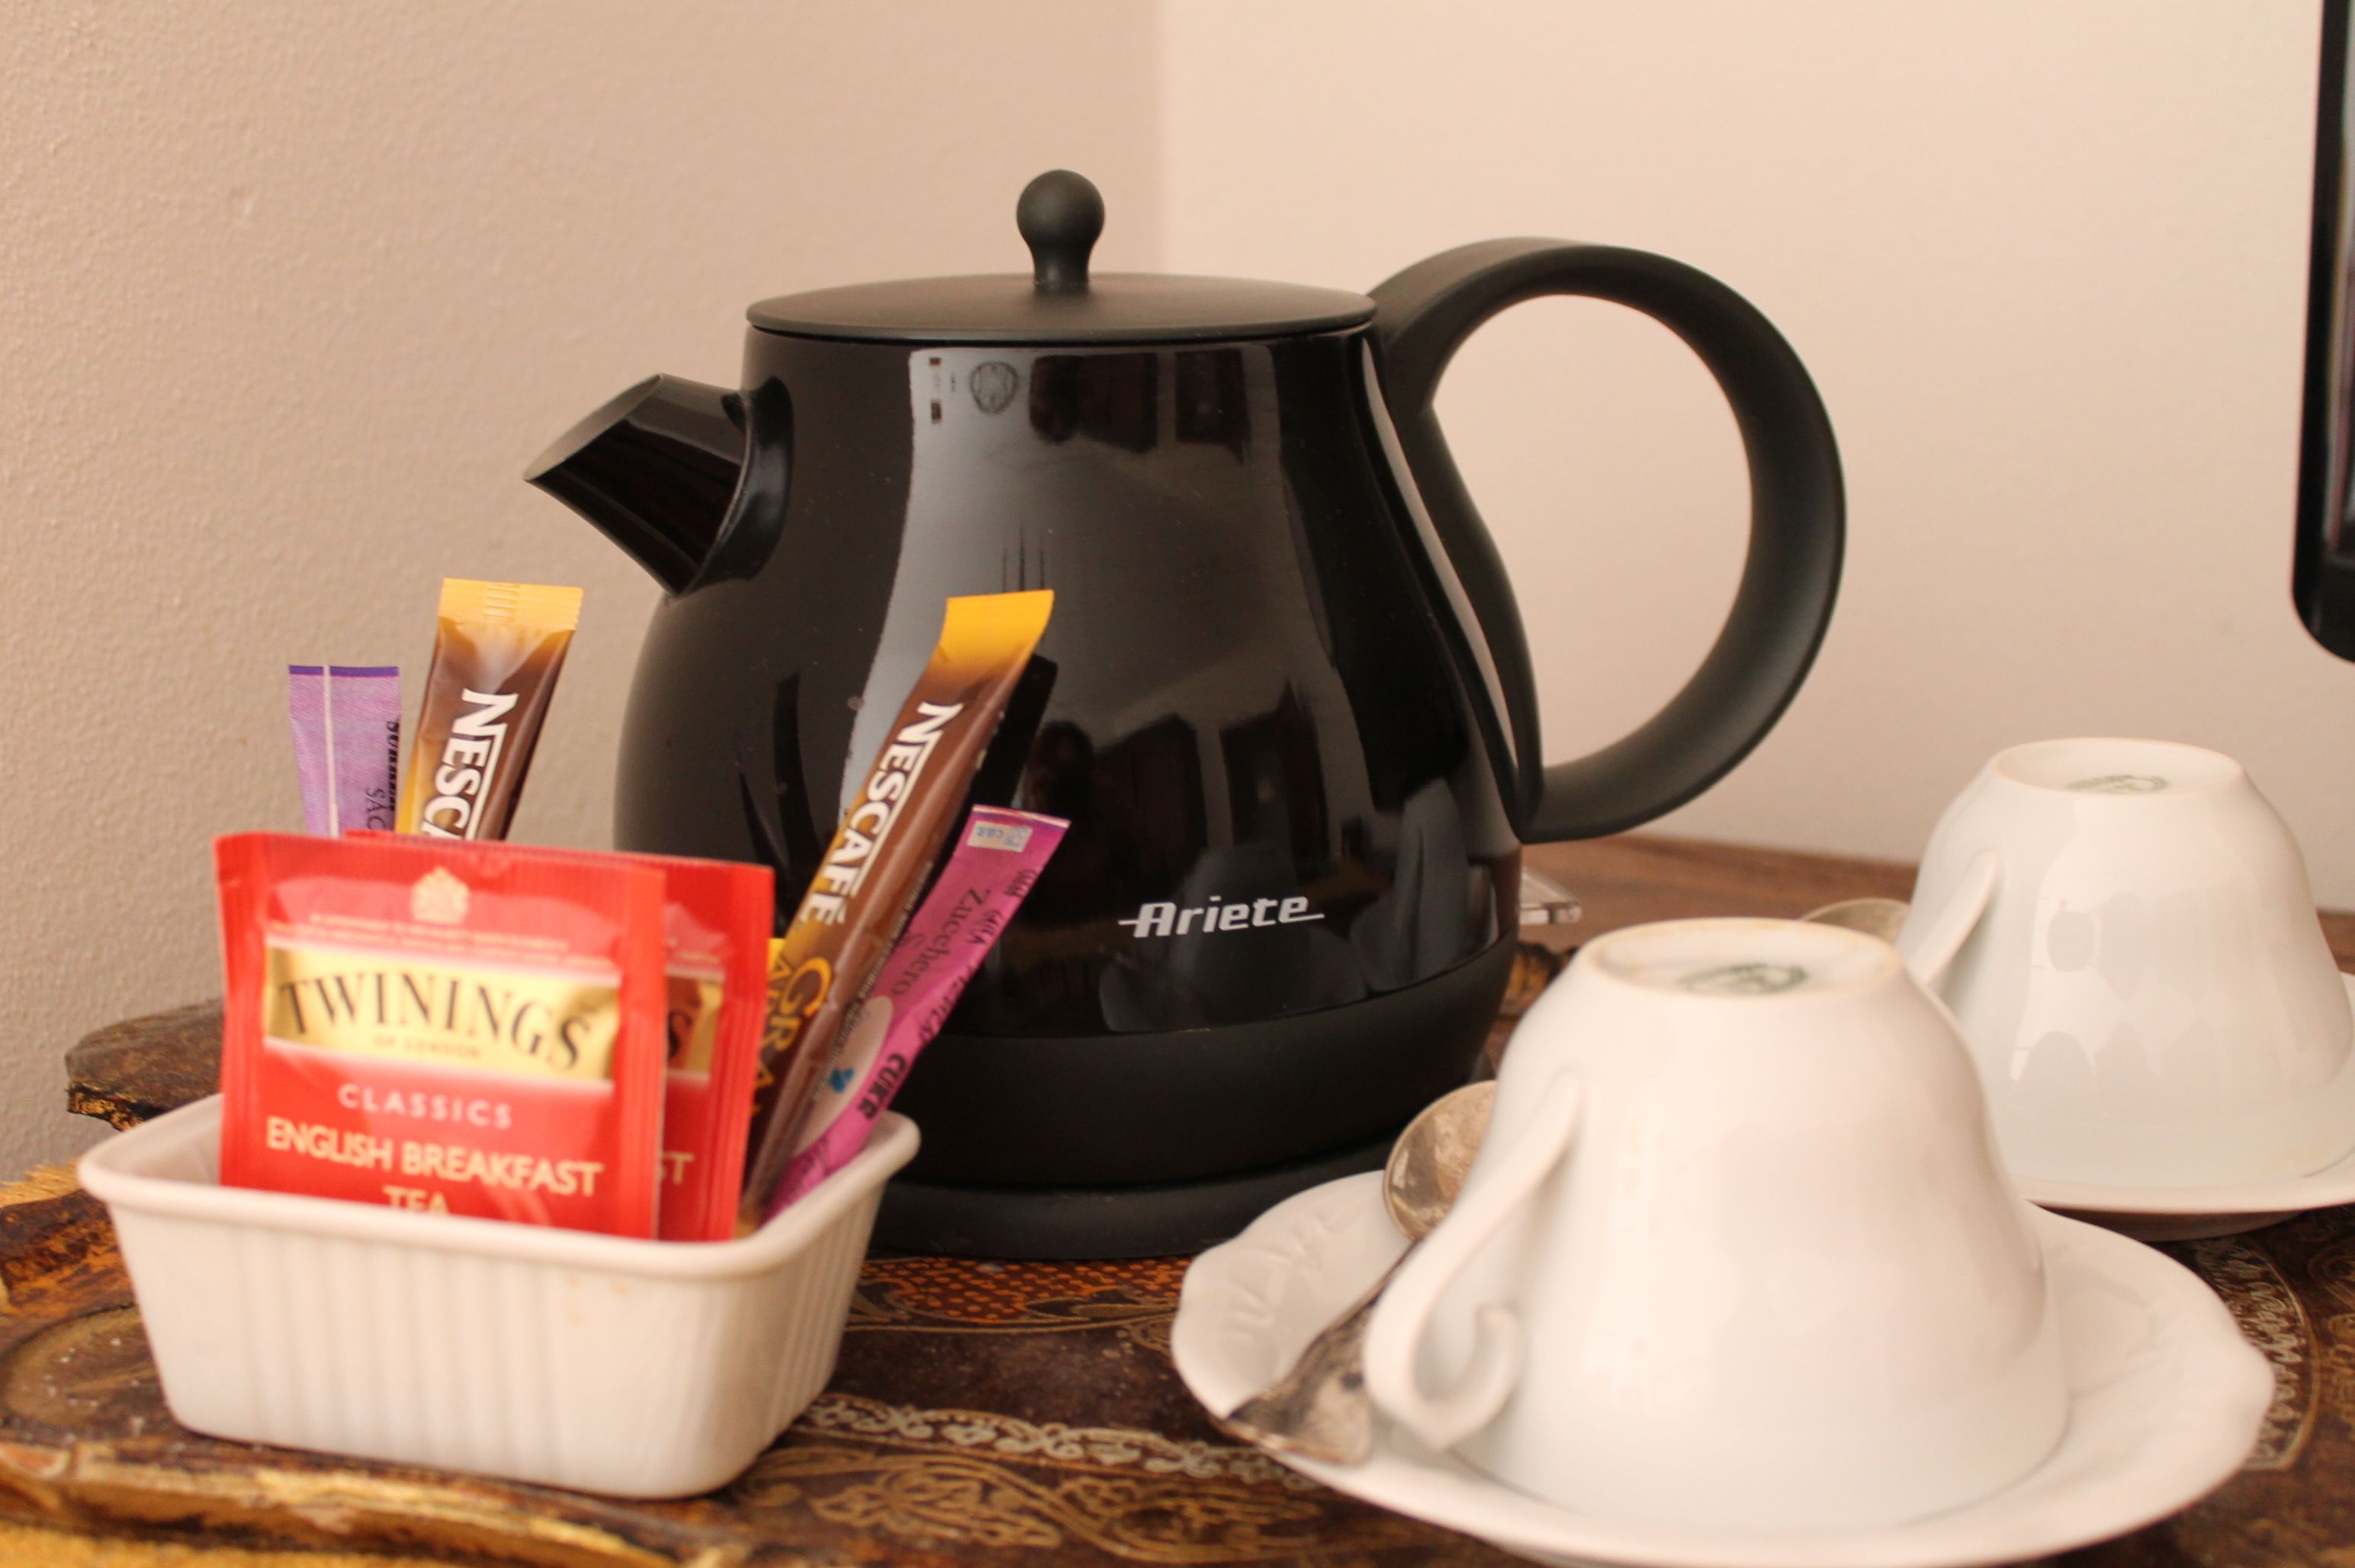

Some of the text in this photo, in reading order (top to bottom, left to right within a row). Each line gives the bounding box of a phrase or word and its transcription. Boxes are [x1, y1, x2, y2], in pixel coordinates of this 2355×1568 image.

[891, 888, 987, 996] Zucchero
[1118, 895, 1325, 938] Ariete
[277, 972, 592, 1072] TWININGS
[337, 1083, 512, 1129] CLASSICS
[265, 1115, 393, 1172] ENGLISH
[400, 1140, 605, 1197] BREAKFAST
[384, 1184, 450, 1215] TEA
